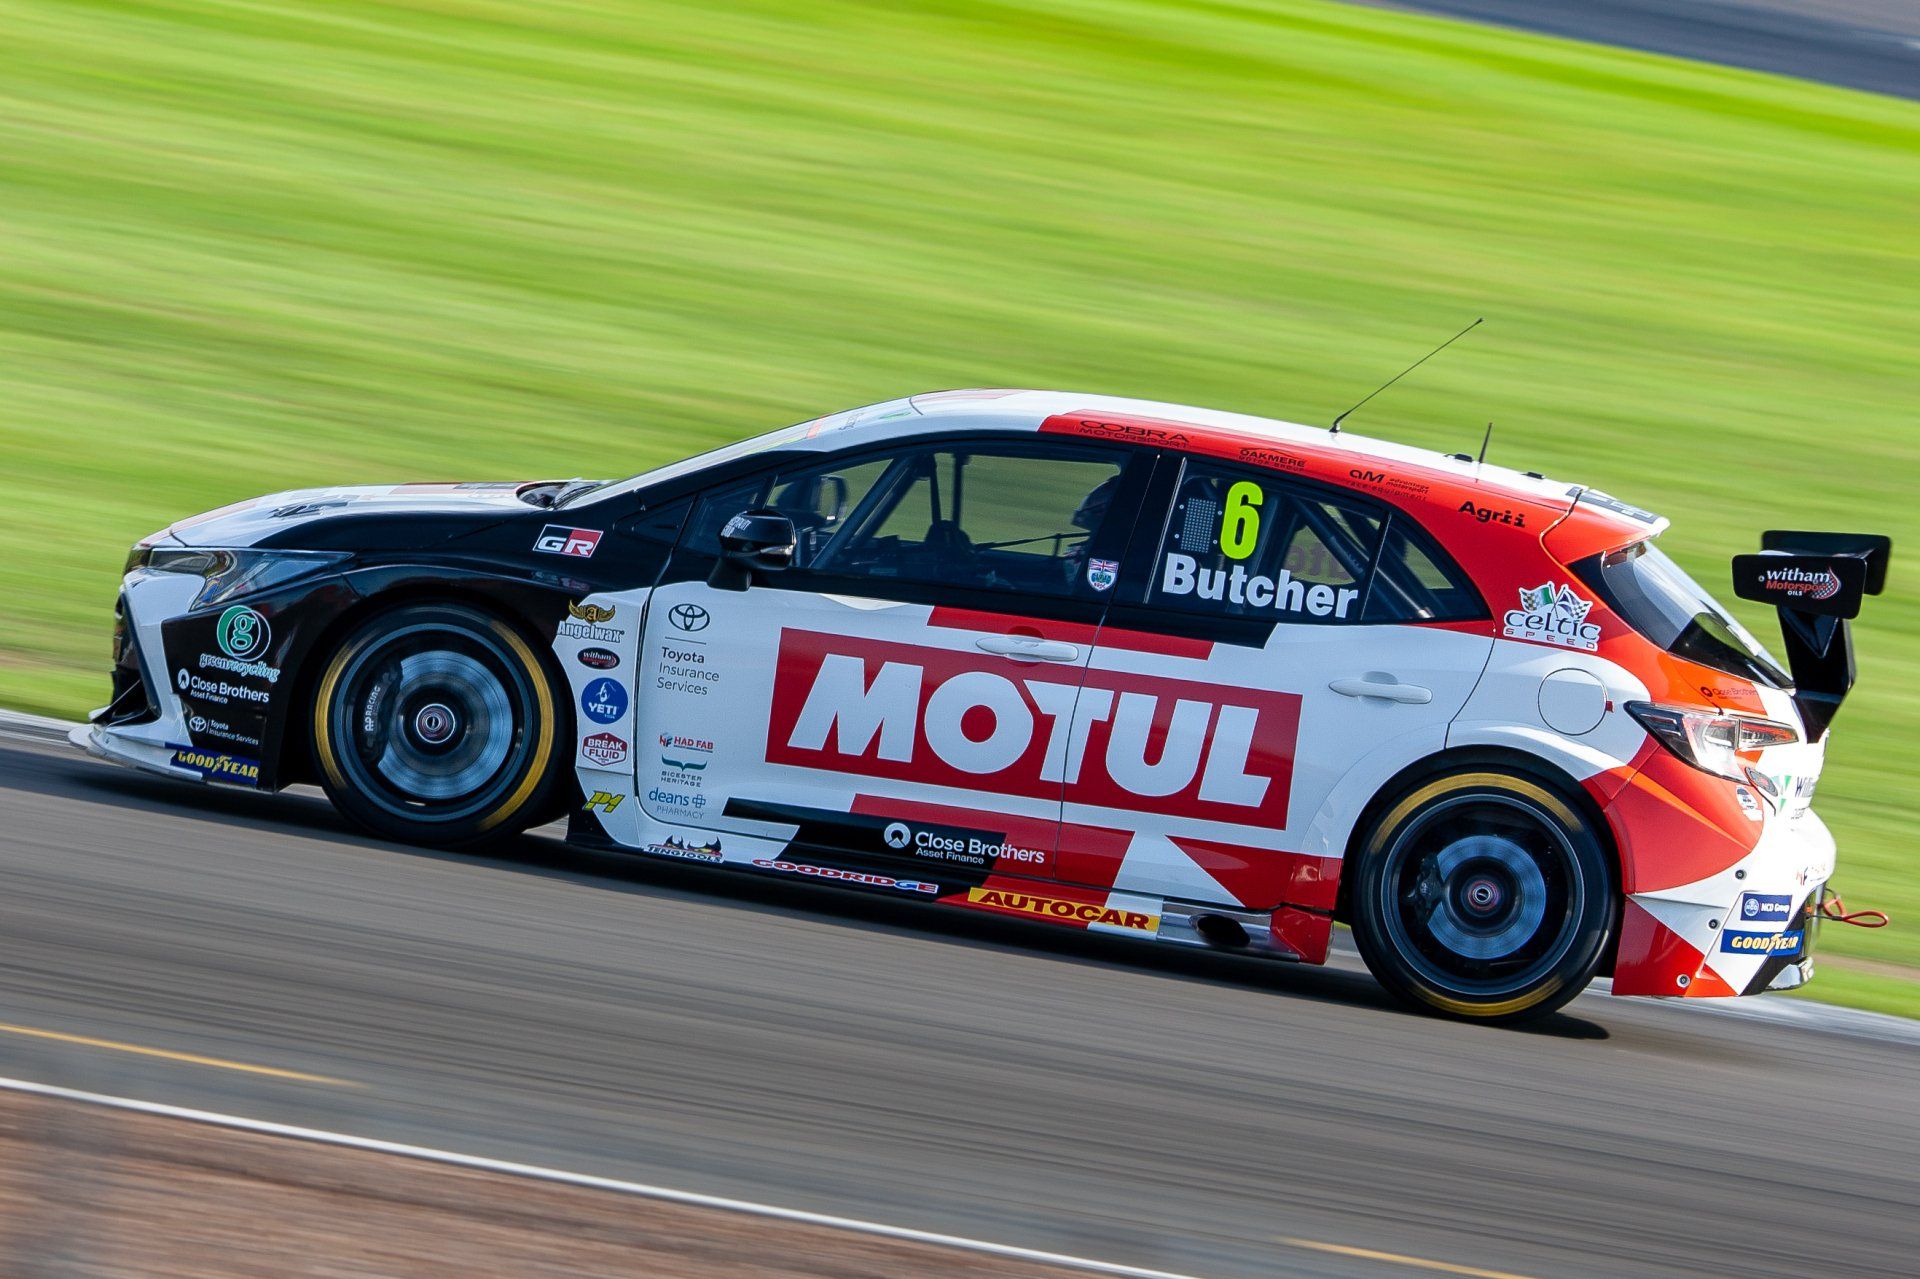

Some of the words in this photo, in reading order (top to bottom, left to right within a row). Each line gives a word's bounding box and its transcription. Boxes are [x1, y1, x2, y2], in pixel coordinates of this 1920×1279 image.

[1079, 428, 1189, 448] MOTORSPORT
[1080, 420, 1189, 443] COBRA
[1240, 449, 1305, 467] OAKMERE
[1220, 481, 1263, 560] 6
[1458, 500, 1526, 528] Agrii
[538, 536, 594, 556] GR
[1766, 567, 1830, 583] witham
[1162, 552, 1359, 619] Butcher
[1765, 580, 1828, 593] Motorsport
[557, 620, 622, 643] Angelwax
[1505, 627, 1595, 649] SPEED
[661, 646, 705, 664] Toyota
[199, 653, 280, 683] greenrecycling
[659, 662, 719, 682] Insurance
[191, 675, 217, 693] Close
[219, 682, 270, 703] Brothers
[656, 676, 708, 696] Services
[588, 701, 617, 716] YETI
[211, 719, 229, 731] Toyota
[787, 653, 1272, 807] MOTUL
[209, 728, 236, 741] Insurance
[236, 734, 259, 746] Services
[587, 738, 623, 751] BREAK
[674, 735, 694, 747] HAD
[696, 740, 714, 750] FAB
[588, 748, 620, 759] FLUID
[660, 777, 701, 787] HERITAGE
[661, 770, 702, 782] BICESTER
[649, 787, 689, 807] deans
[656, 805, 704, 820] PHARMACY
[915, 831, 965, 852] Close
[968, 838, 1045, 864] Brothers
[915, 847, 944, 860] Asset
[946, 851, 985, 865] Finance
[752, 859, 939, 894] GOODRIDGE
[979, 891, 1150, 930] AUTOCAR
[1731, 933, 1799, 953] GOODYEAR
